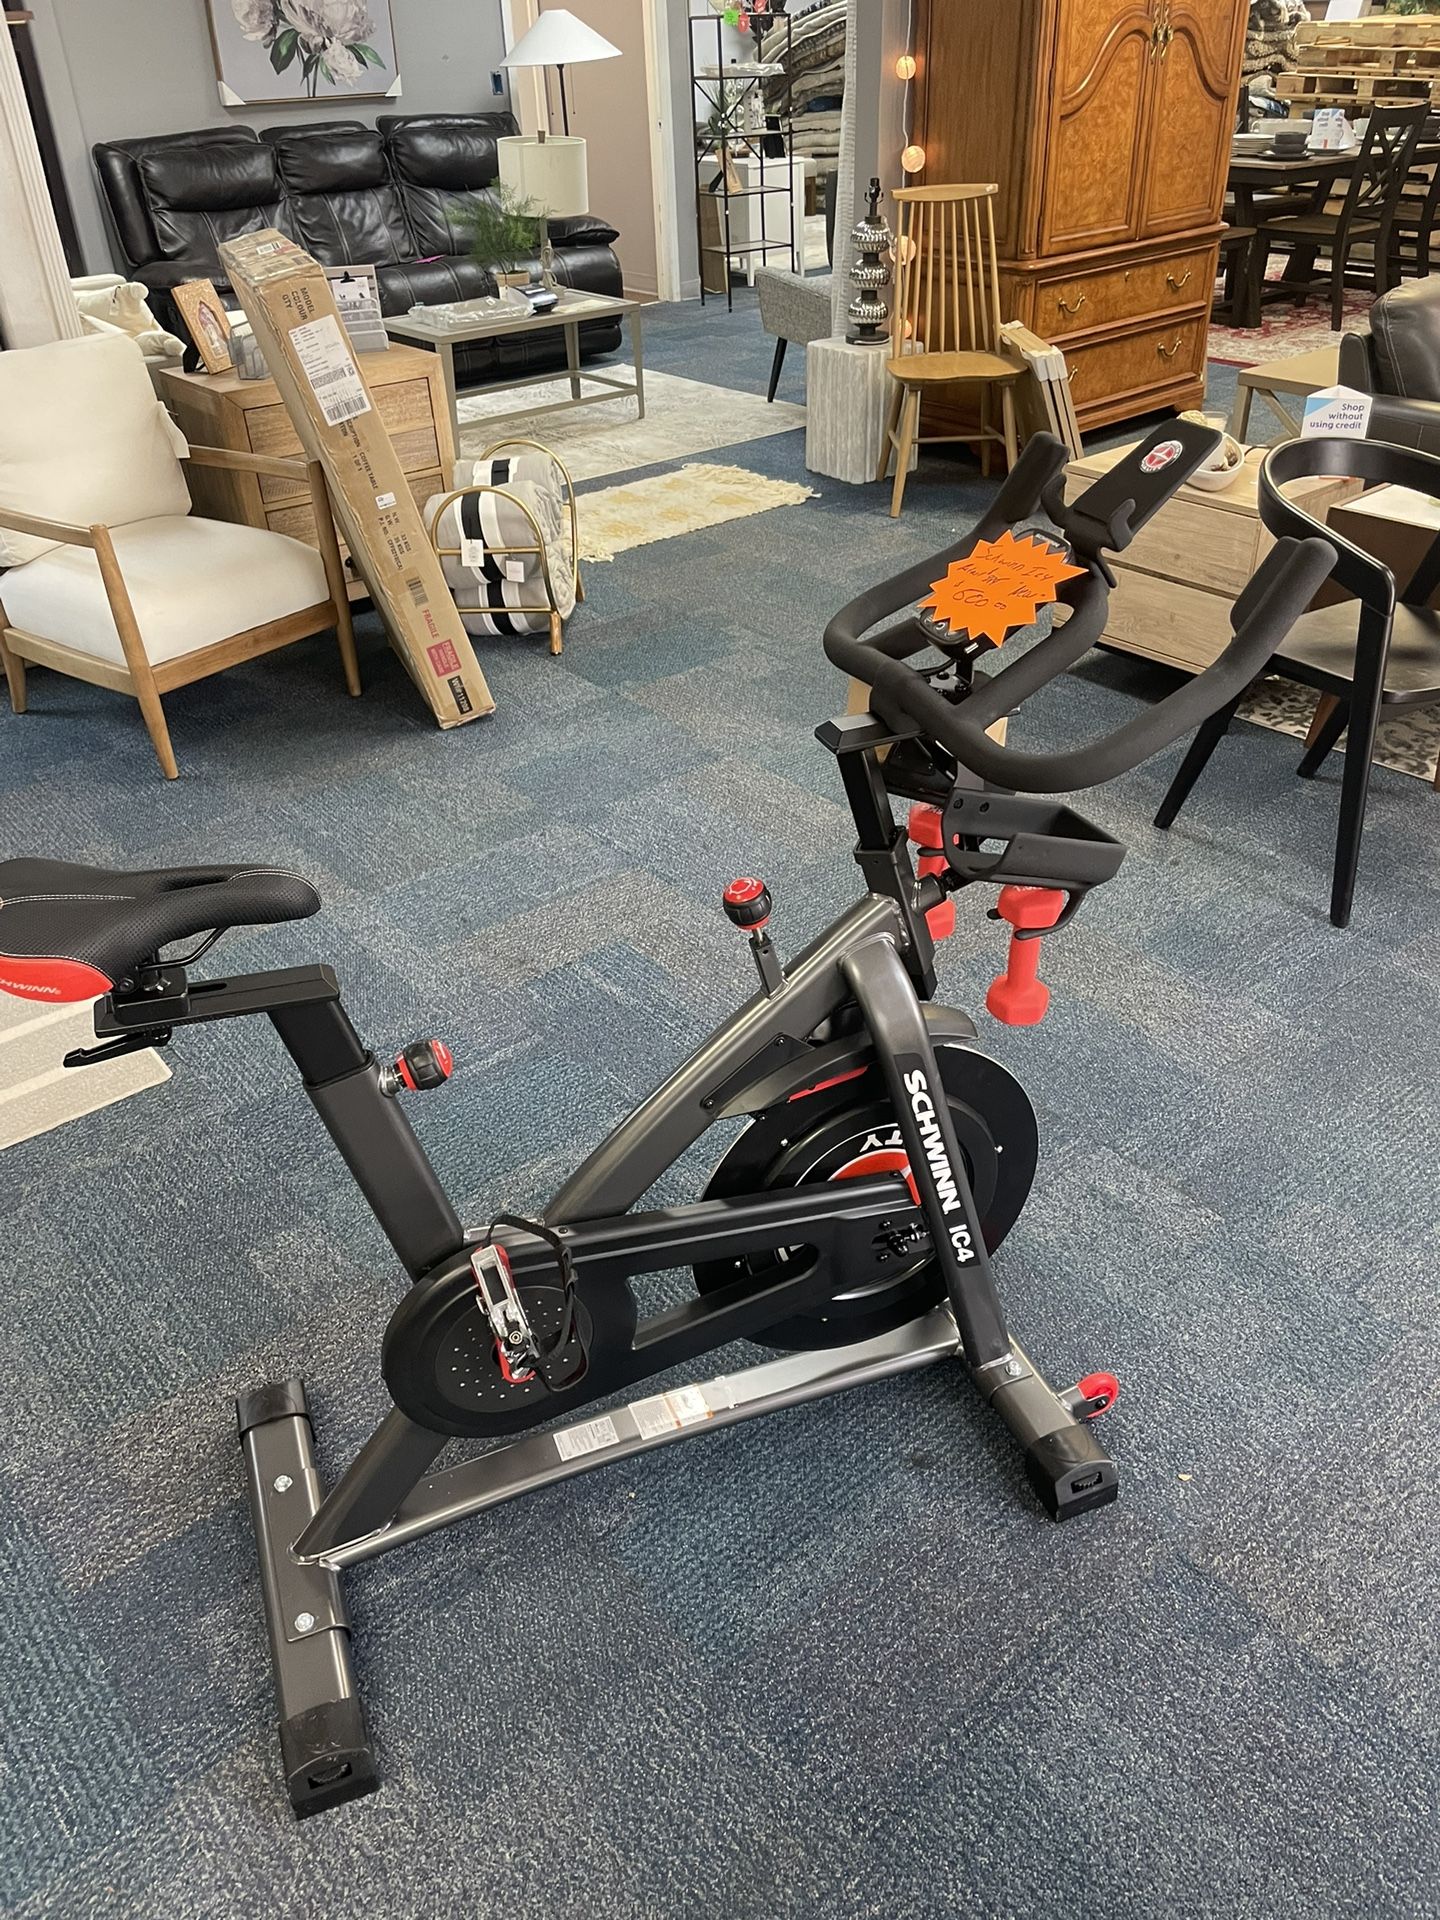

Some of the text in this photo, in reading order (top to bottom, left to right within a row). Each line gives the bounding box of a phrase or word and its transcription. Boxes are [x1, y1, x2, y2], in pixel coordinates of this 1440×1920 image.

[281, 293, 292, 309] QTY
[290, 289, 308, 320] COLOUR
[299, 286, 315, 313] MODEL
[1328, 412, 1363, 420] without
[1342, 403, 1365, 412] Shop
[1310, 421, 1361, 430] using credit
[421, 608, 439, 639] FRAGILE
[904, 1069, 975, 1263] SCHWINN IC4
